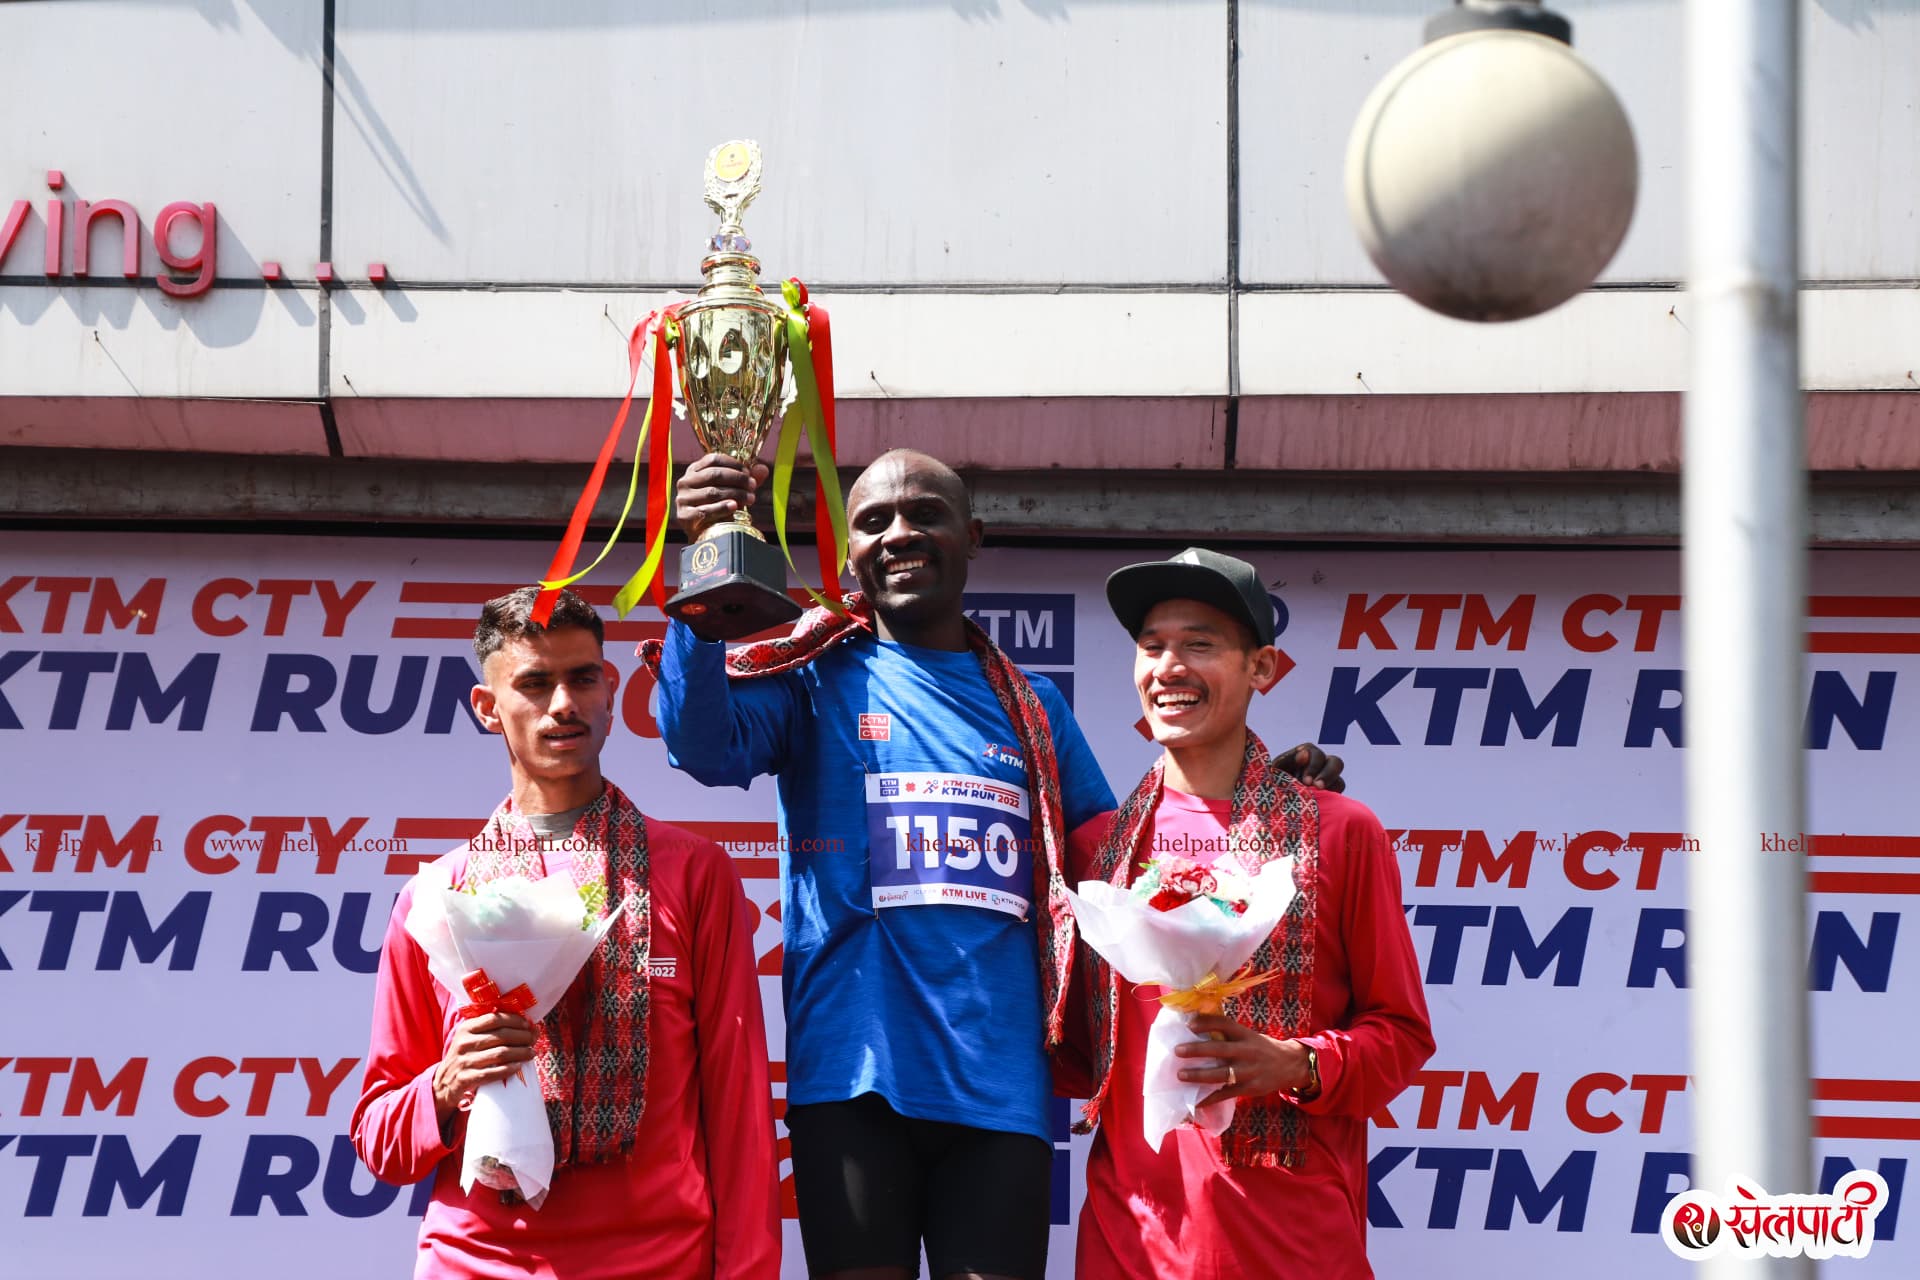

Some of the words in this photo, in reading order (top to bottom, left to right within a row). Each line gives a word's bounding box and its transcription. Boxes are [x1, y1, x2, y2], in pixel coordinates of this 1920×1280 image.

[192, 578, 376, 637] CTY
[962, 610, 1054, 648] TM
[1338, 593, 1537, 651] KTM
[1562, 593, 1684, 653] CT
[862, 716, 888, 725] KTM
[862, 730, 887, 738] CTY
[1318, 666, 1593, 747] KTM
[1623, 668, 1897, 750] RN
[943, 779, 963, 787] KTM
[964, 781, 981, 789] CTY
[1000, 753, 1023, 769] KTM
[941, 787, 968, 797] KTM
[971, 789, 996, 801] RUN
[998, 794, 1020, 809] 2022
[184, 814, 370, 875] CTY
[886, 815, 1018, 877] 1150
[1385, 829, 1537, 889] TM
[1563, 830, 1684, 891] CT
[942, 888, 963, 898] KTM
[965, 890, 988, 901] LIVE
[0, 890, 212, 971] TM
[241, 891, 400, 974] RU
[1402, 904, 1594, 987] TM
[1626, 908, 1901, 993] RN
[649, 966, 676, 977] 2022
[0, 1057, 149, 1117] TM
[173, 1056, 361, 1117] CTY
[1565, 1072, 1695, 1134] CT
[0, 1134, 202, 1217] TM
[230, 1134, 440, 1219] RU
[1630, 1152, 1908, 1241] RN
